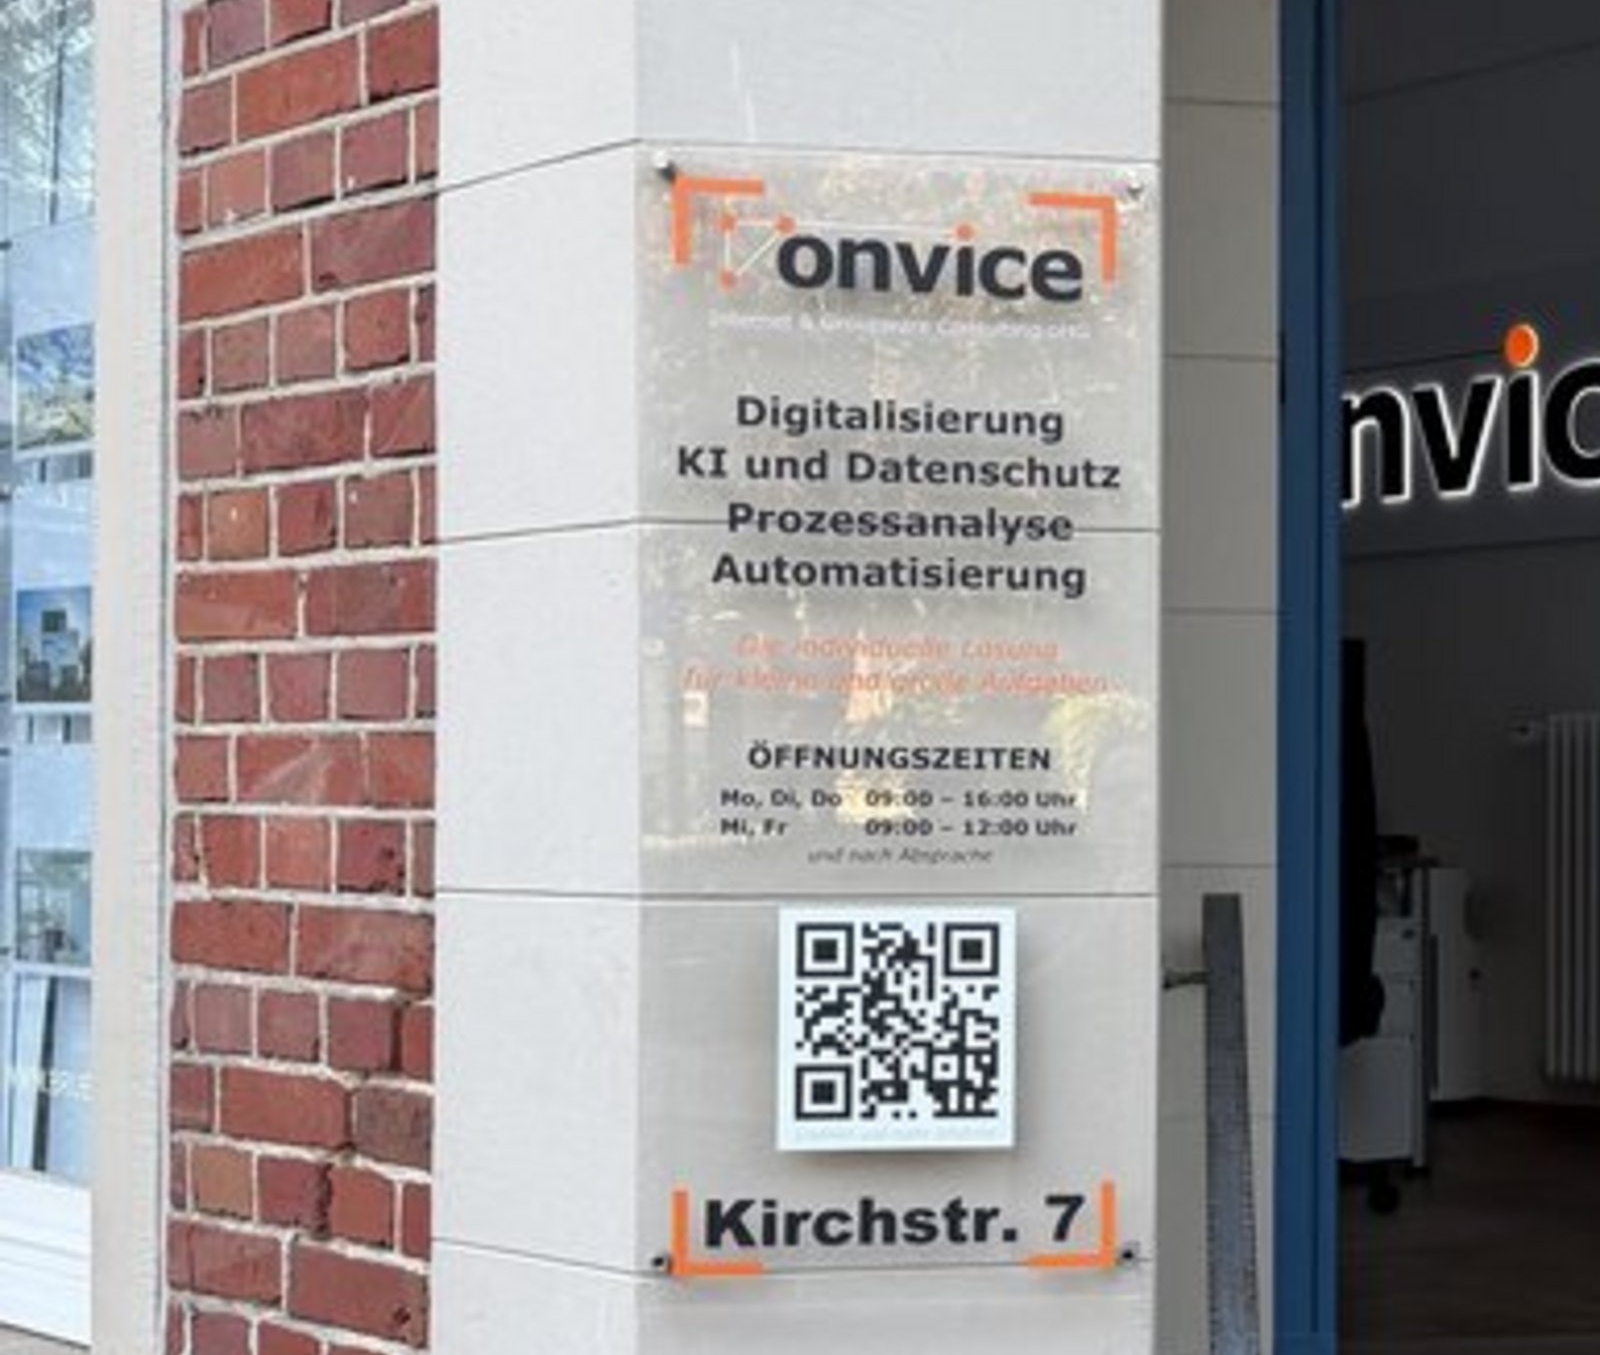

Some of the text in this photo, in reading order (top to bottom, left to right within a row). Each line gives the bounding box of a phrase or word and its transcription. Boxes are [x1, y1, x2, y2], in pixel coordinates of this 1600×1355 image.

[776, 222, 1083, 302] onvice
[736, 395, 1064, 444] Digitalisierung
[678, 446, 1120, 489] KI und Datenschutz
[727, 502, 1074, 545] Prozessanalyse
[711, 553, 1087, 599] Automatisierung
[748, 740, 1051, 770] ÖFFNUNGSZEITEN
[720, 788, 763, 809] Mo,
[770, 788, 802, 809] Di,
[811, 788, 842, 807] Do
[865, 788, 934, 808] 09:00
[963, 790, 1029, 808] 16:00
[1035, 790, 1076, 808] Uhr
[720, 817, 755, 837] Mi,
[763, 817, 788, 836] Fr
[865, 818, 934, 837] 09:00
[963, 818, 1029, 837] 12:00
[1035, 818, 1077, 837] Uhr
[704, 1194, 1085, 1249] Kirchstr. 7
